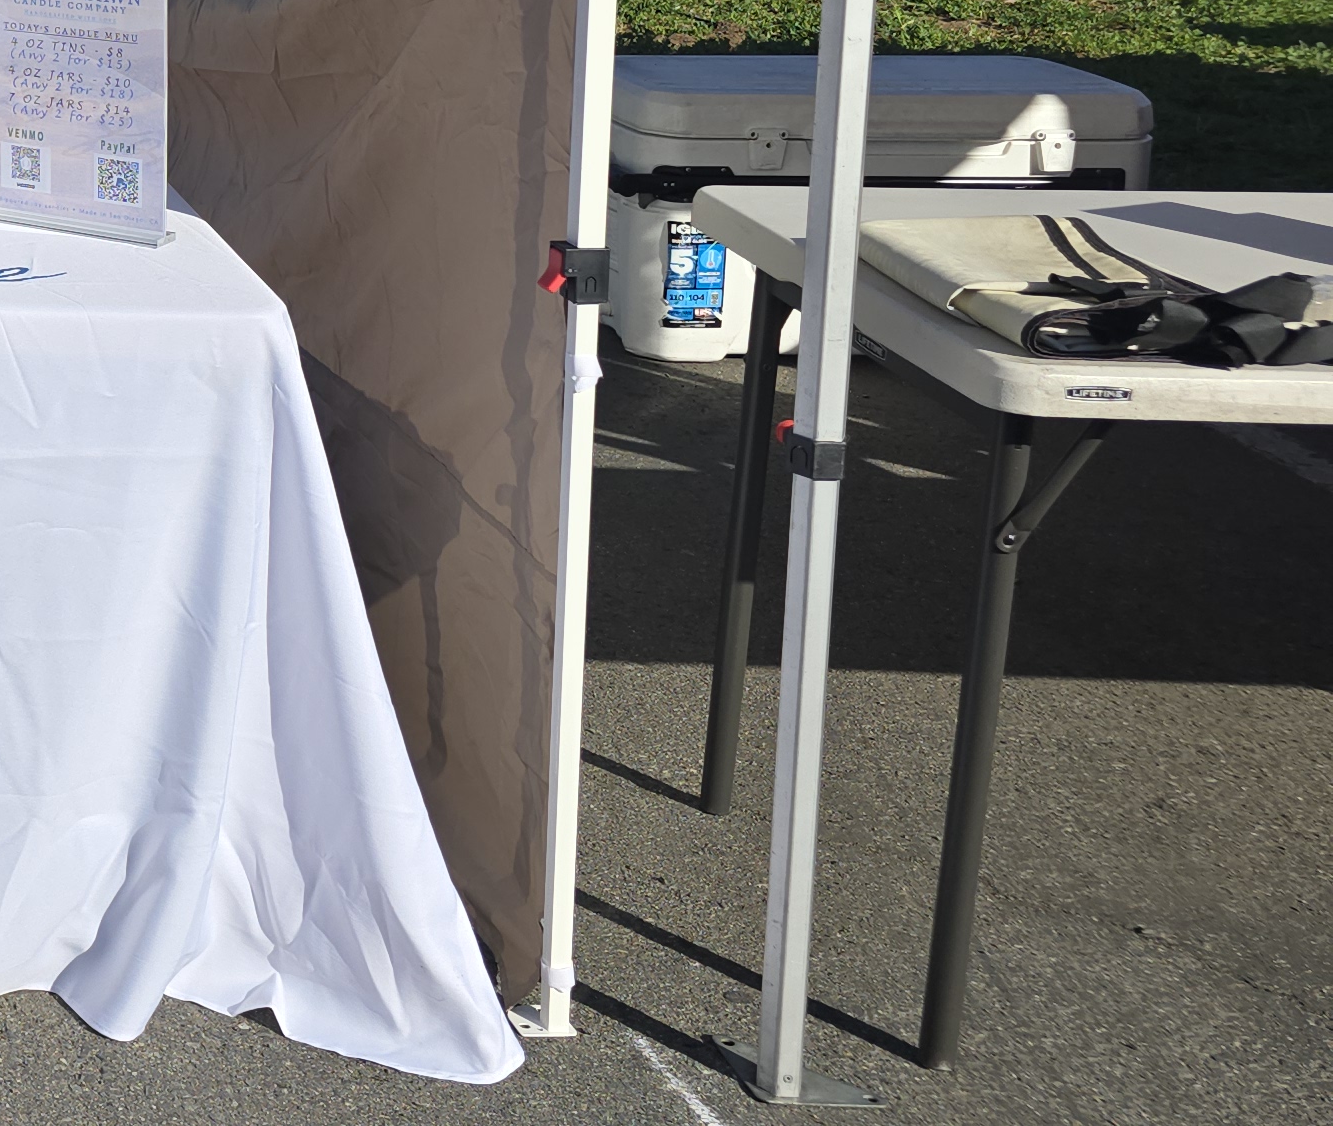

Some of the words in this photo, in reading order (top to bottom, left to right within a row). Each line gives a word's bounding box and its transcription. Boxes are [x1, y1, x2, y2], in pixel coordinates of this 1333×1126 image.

[67, 2, 127, 14] COMPANY
[3, 22, 49, 33] TODAY'S
[54, 26, 100, 38] CANDLE
[105, 31, 139, 42] MENU
[11, 37, 18, 46] 4
[26, 39, 44, 49] OZ
[52, 41, 86, 54] TINS
[107, 47, 123, 58] $8
[10, 48, 46, 63] (Any
[53, 53, 60, 62] 2
[68, 54, 90, 65] for
[97, 57, 132, 71] $15)
[8, 65, 15, 74] 4
[23, 67, 41, 78] OZ
[46, 70, 83, 83] JARS
[105, 76, 131, 88] $10
[13, 76, 48, 92] (Any
[55, 82, 62, 91] 2
[70, 83, 93, 95] for
[100, 87, 134, 101] $18)
[8, 92, 15, 101] 7
[23, 95, 41, 105] OZ
[46, 97, 84, 111] JARS
[104, 103, 131, 116] $14
[12, 103, 48, 119] (Any
[55, 109, 62, 119] 2
[70, 110, 92, 122] for
[99, 114, 133, 129] $25)
[7, 127, 44, 141] VENMO
[100, 139, 136, 155] PayPal
[670, 249, 694, 274] 5
[1072, 389, 1125, 398] LIFETIME
